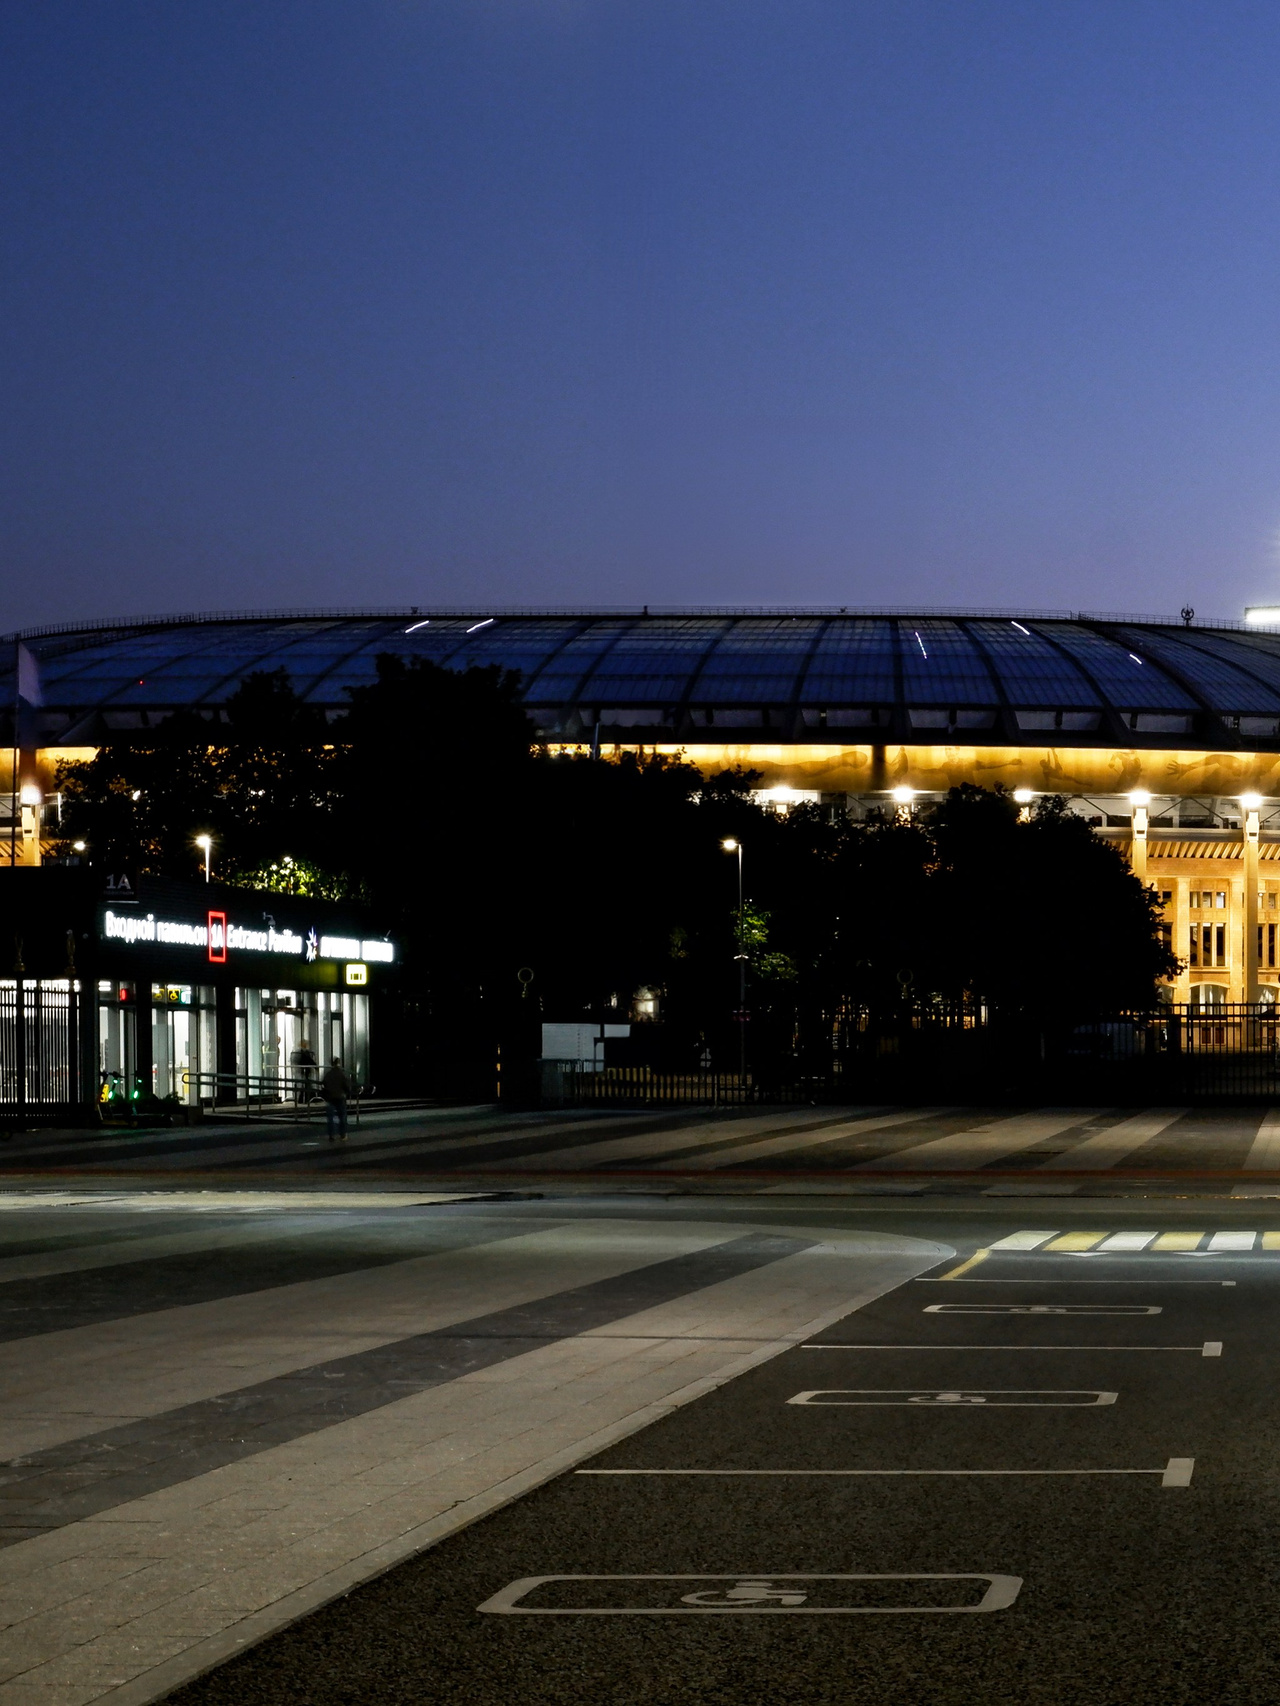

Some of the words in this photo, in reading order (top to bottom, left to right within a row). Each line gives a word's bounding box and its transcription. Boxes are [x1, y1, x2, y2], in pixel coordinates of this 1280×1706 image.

[105, 910, 155, 944] Входной
[157, 920, 207, 946] павильон
[227, 924, 267, 951] Entrance
